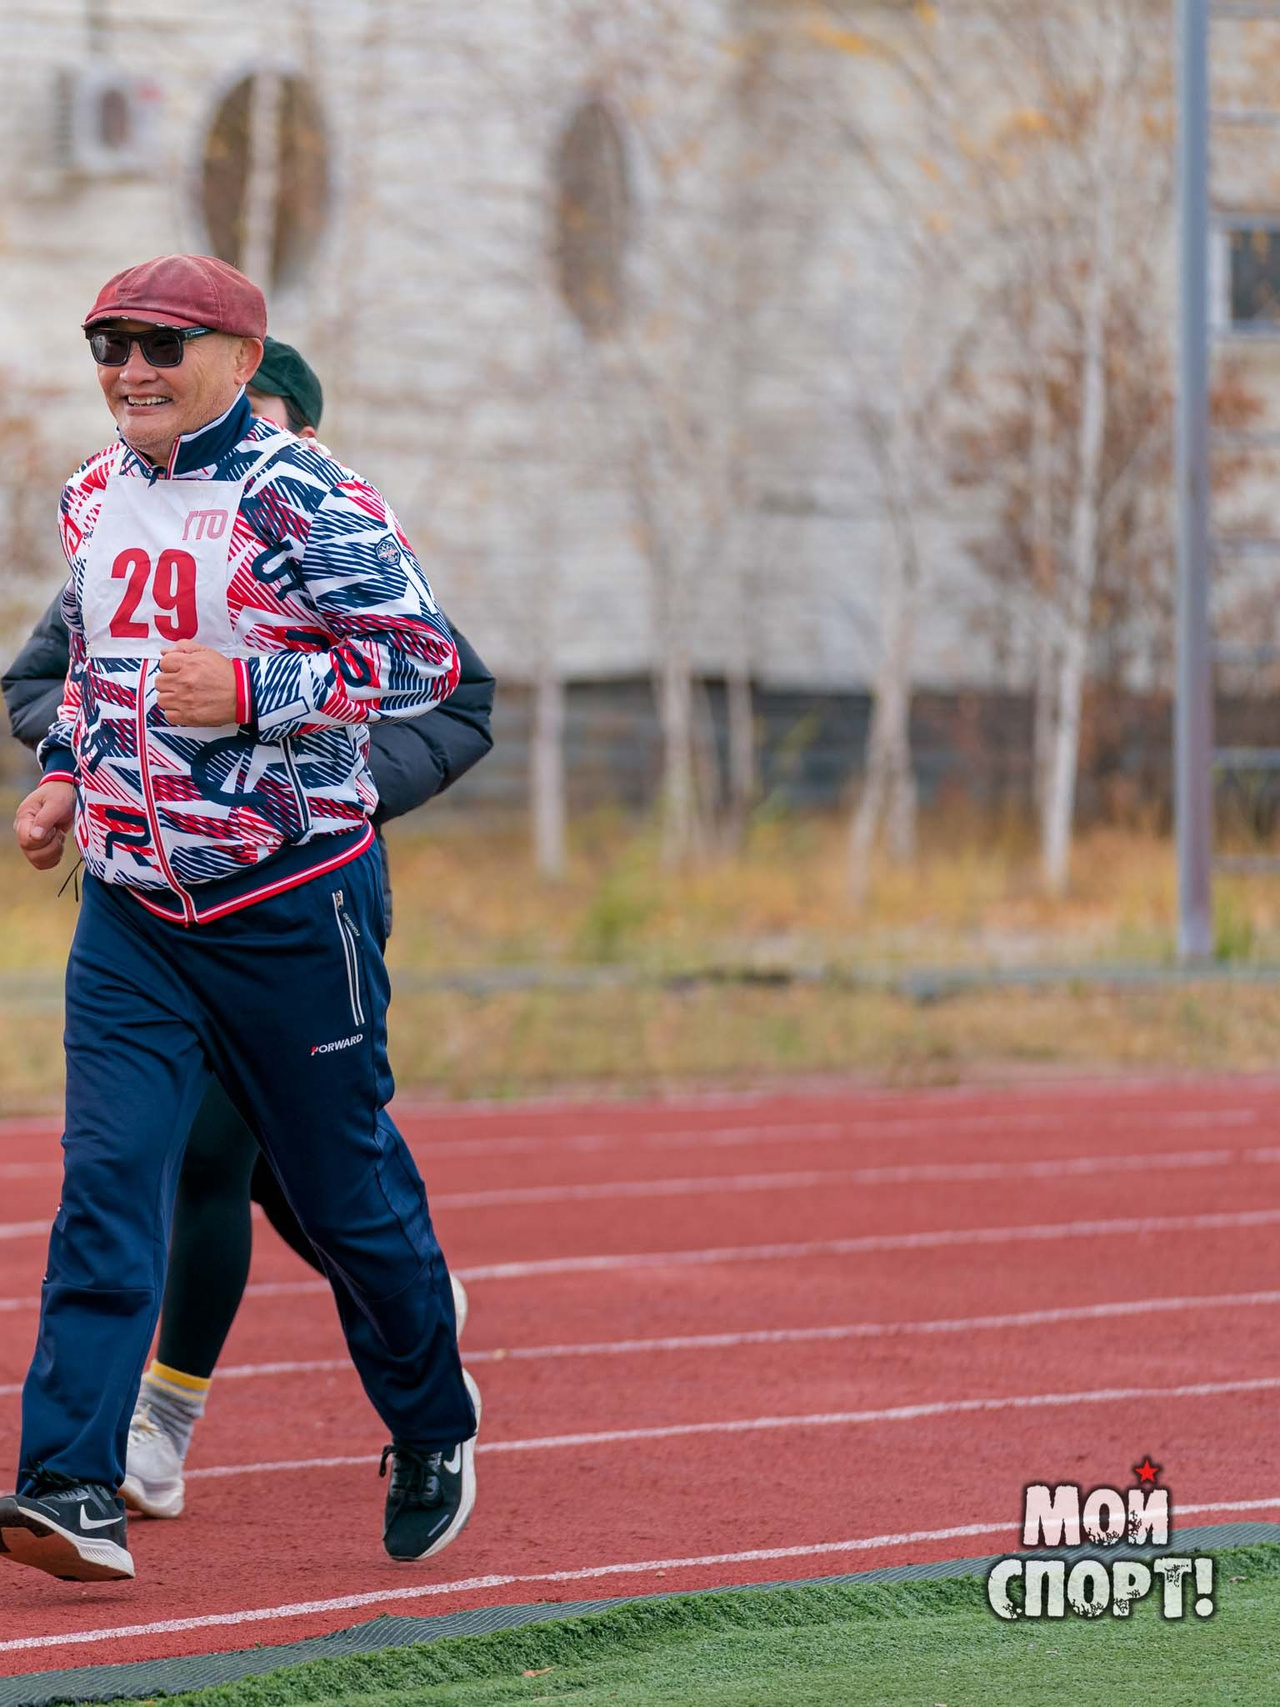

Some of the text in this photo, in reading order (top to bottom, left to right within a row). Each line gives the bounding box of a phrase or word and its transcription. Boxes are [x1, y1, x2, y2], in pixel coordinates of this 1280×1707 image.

[182, 509, 229, 541] ГТО
[109, 547, 198, 642] 29
[310, 1033, 364, 1056] FORWARD
